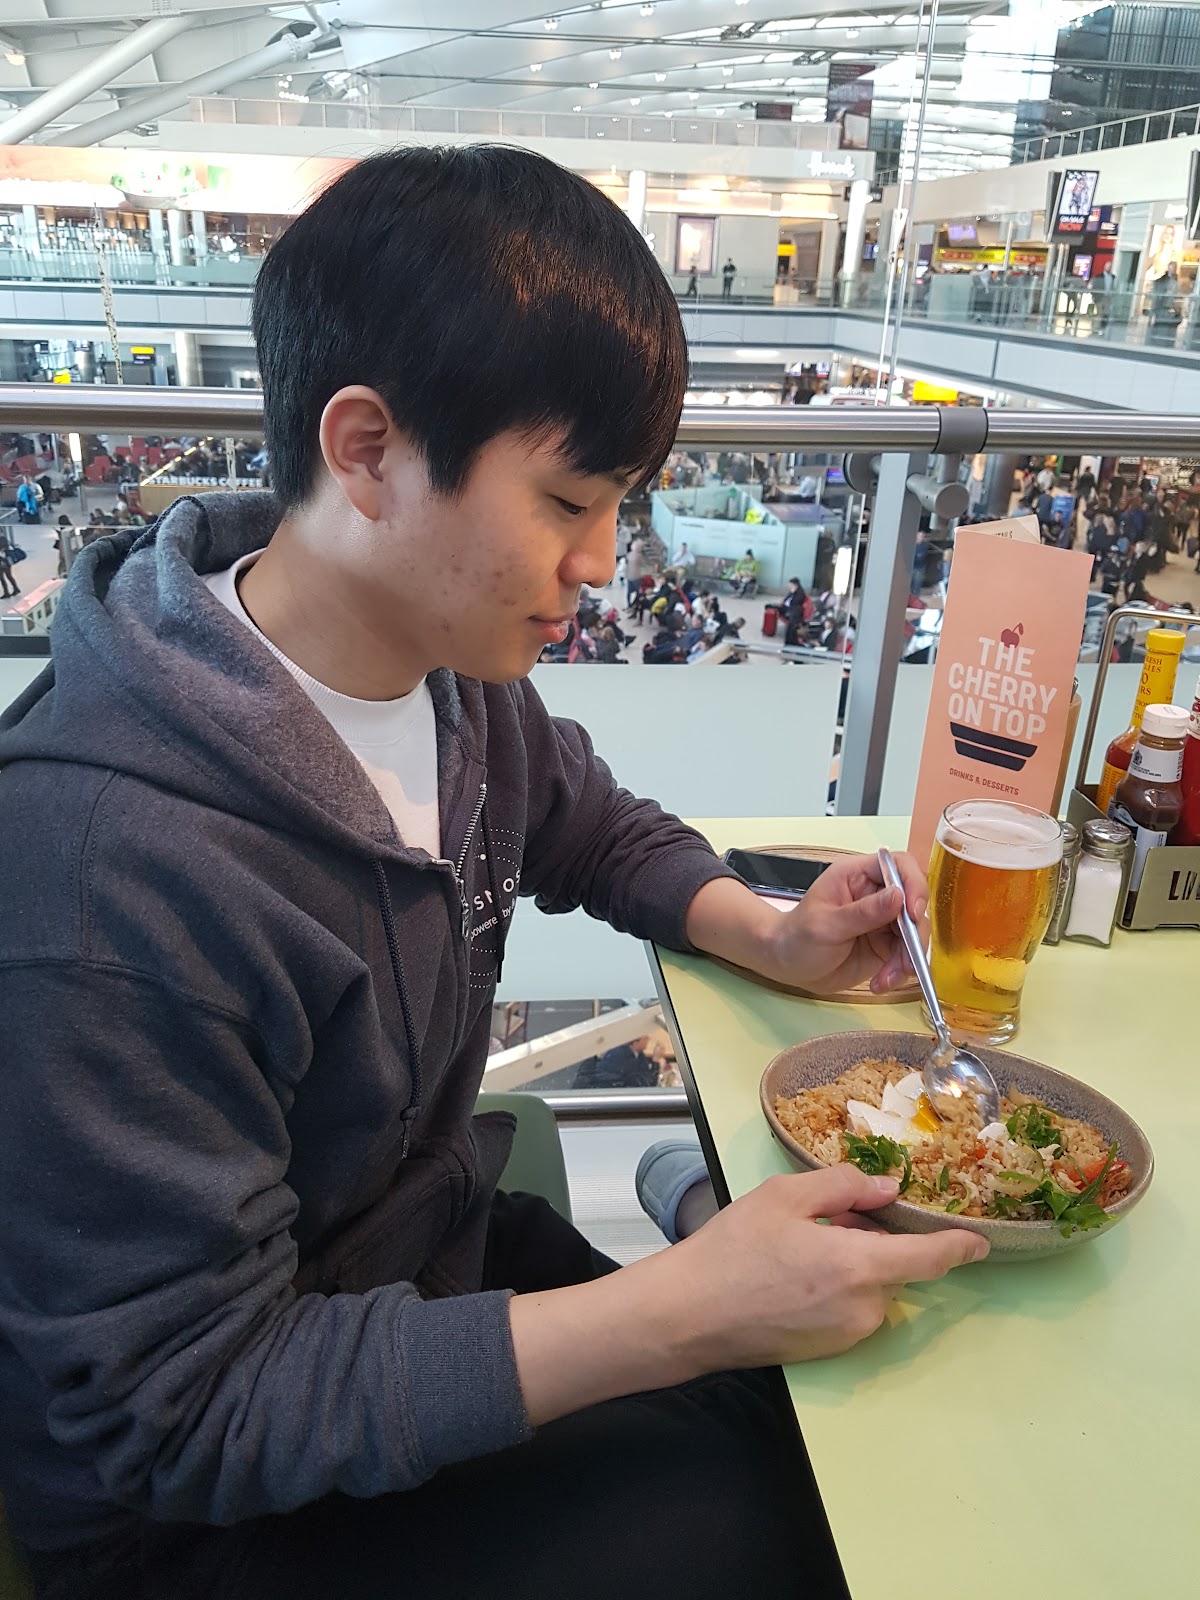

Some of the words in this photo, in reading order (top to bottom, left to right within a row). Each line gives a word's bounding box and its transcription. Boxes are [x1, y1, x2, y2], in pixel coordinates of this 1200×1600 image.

[149, 475, 218, 487] STARBUCKS
[218, 476, 263, 488] CFFEE
[978, 636, 1035, 678] THE
[948, 662, 1057, 714] CHERRY
[948, 693, 984, 726] ON
[989, 703, 1046, 740] TOP
[949, 767, 974, 782] DRINKS
[975, 776, 981, 785] &
[982, 778, 1019, 796] DESSERTS
[470, 916, 499, 942] powere
